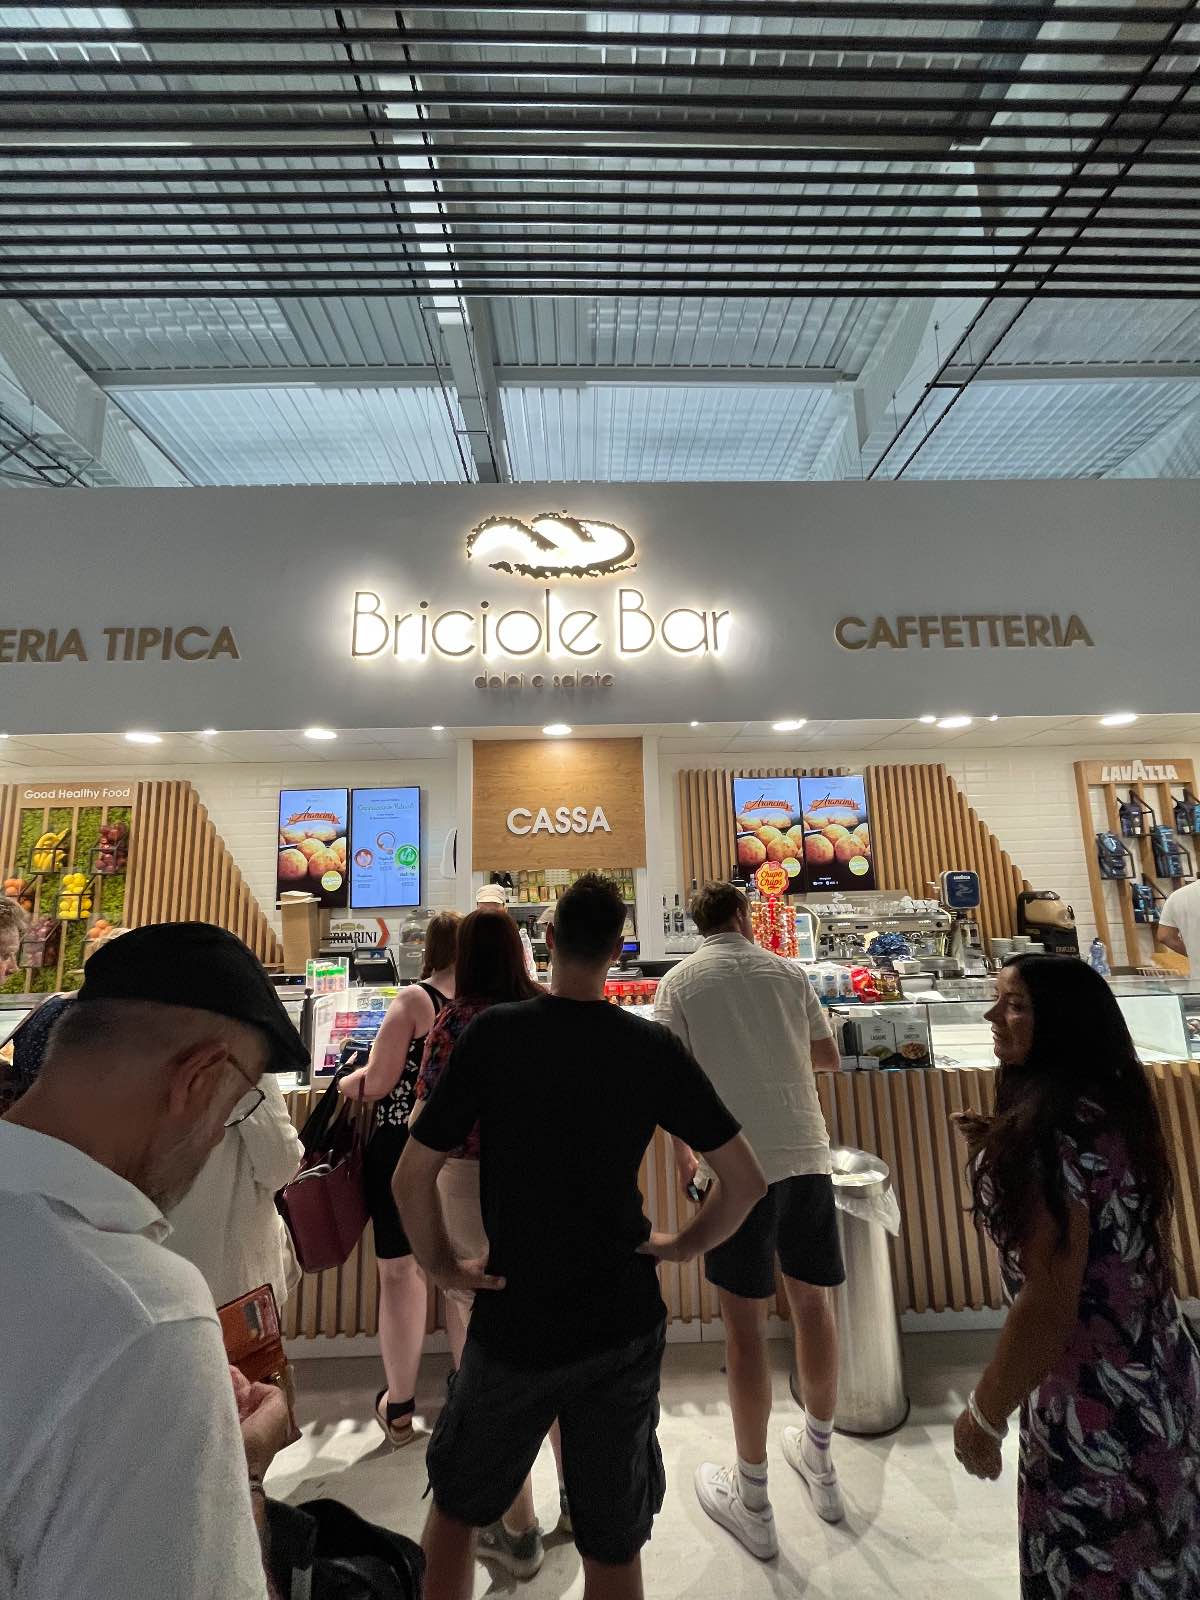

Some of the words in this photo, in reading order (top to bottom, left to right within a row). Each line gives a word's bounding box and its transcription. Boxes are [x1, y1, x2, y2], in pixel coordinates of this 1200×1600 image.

[351, 588, 602, 657] Briciole
[617, 588, 730, 654] Bar
[833, 613, 1096, 650] CAFFETTERIA
[103, 625, 240, 662] TIPICA
[1101, 759, 1179, 782] LAVAZZA
[24, 789, 56, 799] Good
[58, 789, 100, 799] Healthy
[102, 787, 131, 798] Food
[817, 792, 855, 808] Arancini
[506, 806, 613, 835] CASSA
